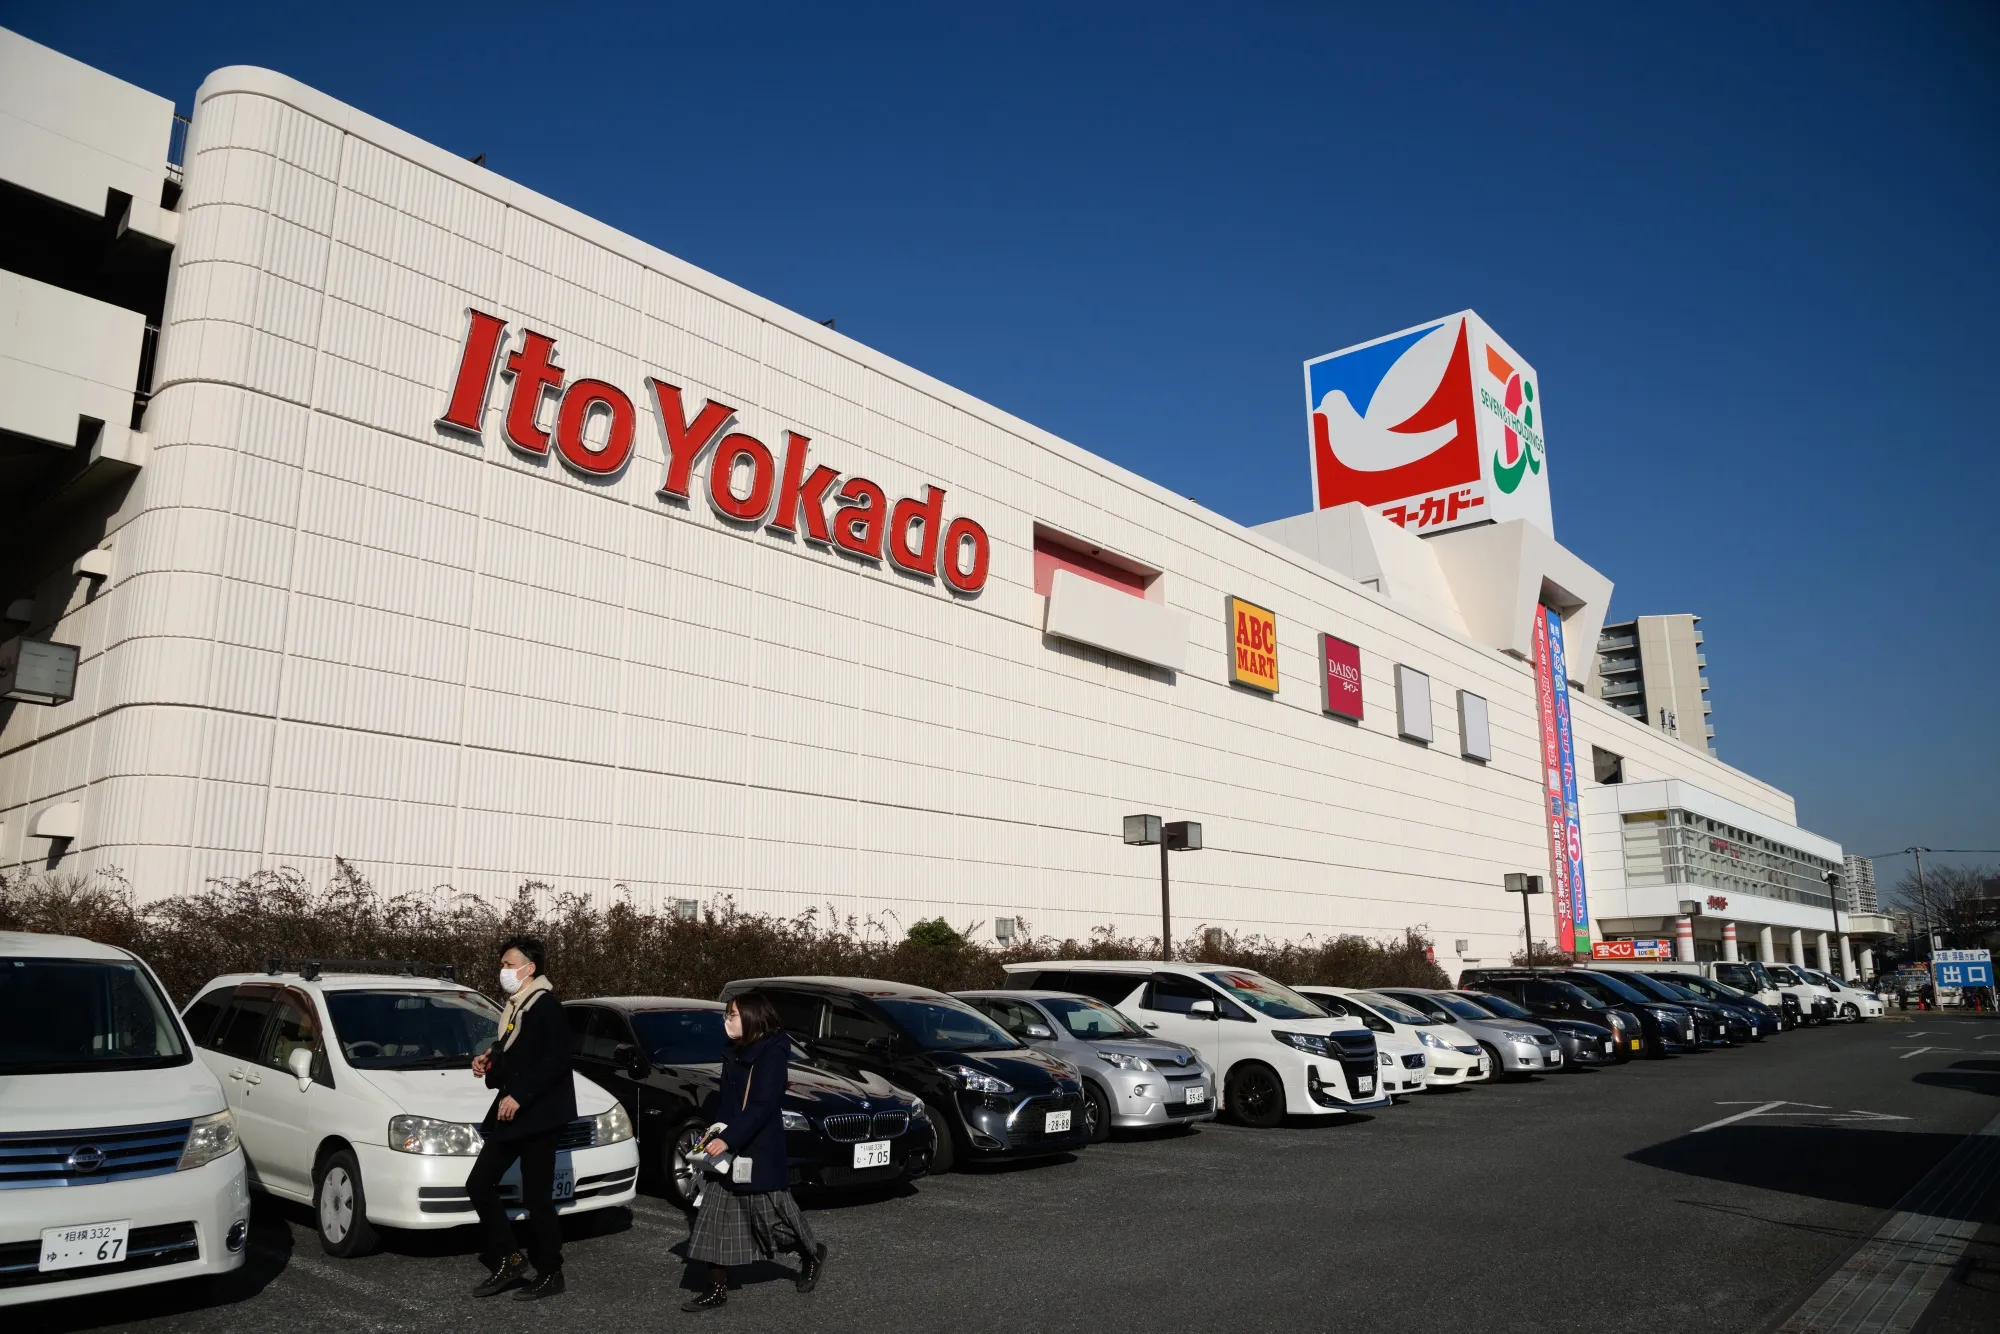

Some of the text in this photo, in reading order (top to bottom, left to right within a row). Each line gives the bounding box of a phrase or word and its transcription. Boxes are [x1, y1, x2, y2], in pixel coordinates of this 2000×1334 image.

[1511, 413, 1544, 455] HOLDINGS
[1236, 610, 1275, 655] ABC
[1236, 646, 1276, 681] MART
[1328, 658, 1359, 682] DAISO
[1596, 944, 1631, 956] 宝くじ
[1943, 965, 1987, 983] 出口
[46, 1252, 57, 1263] ゆ
